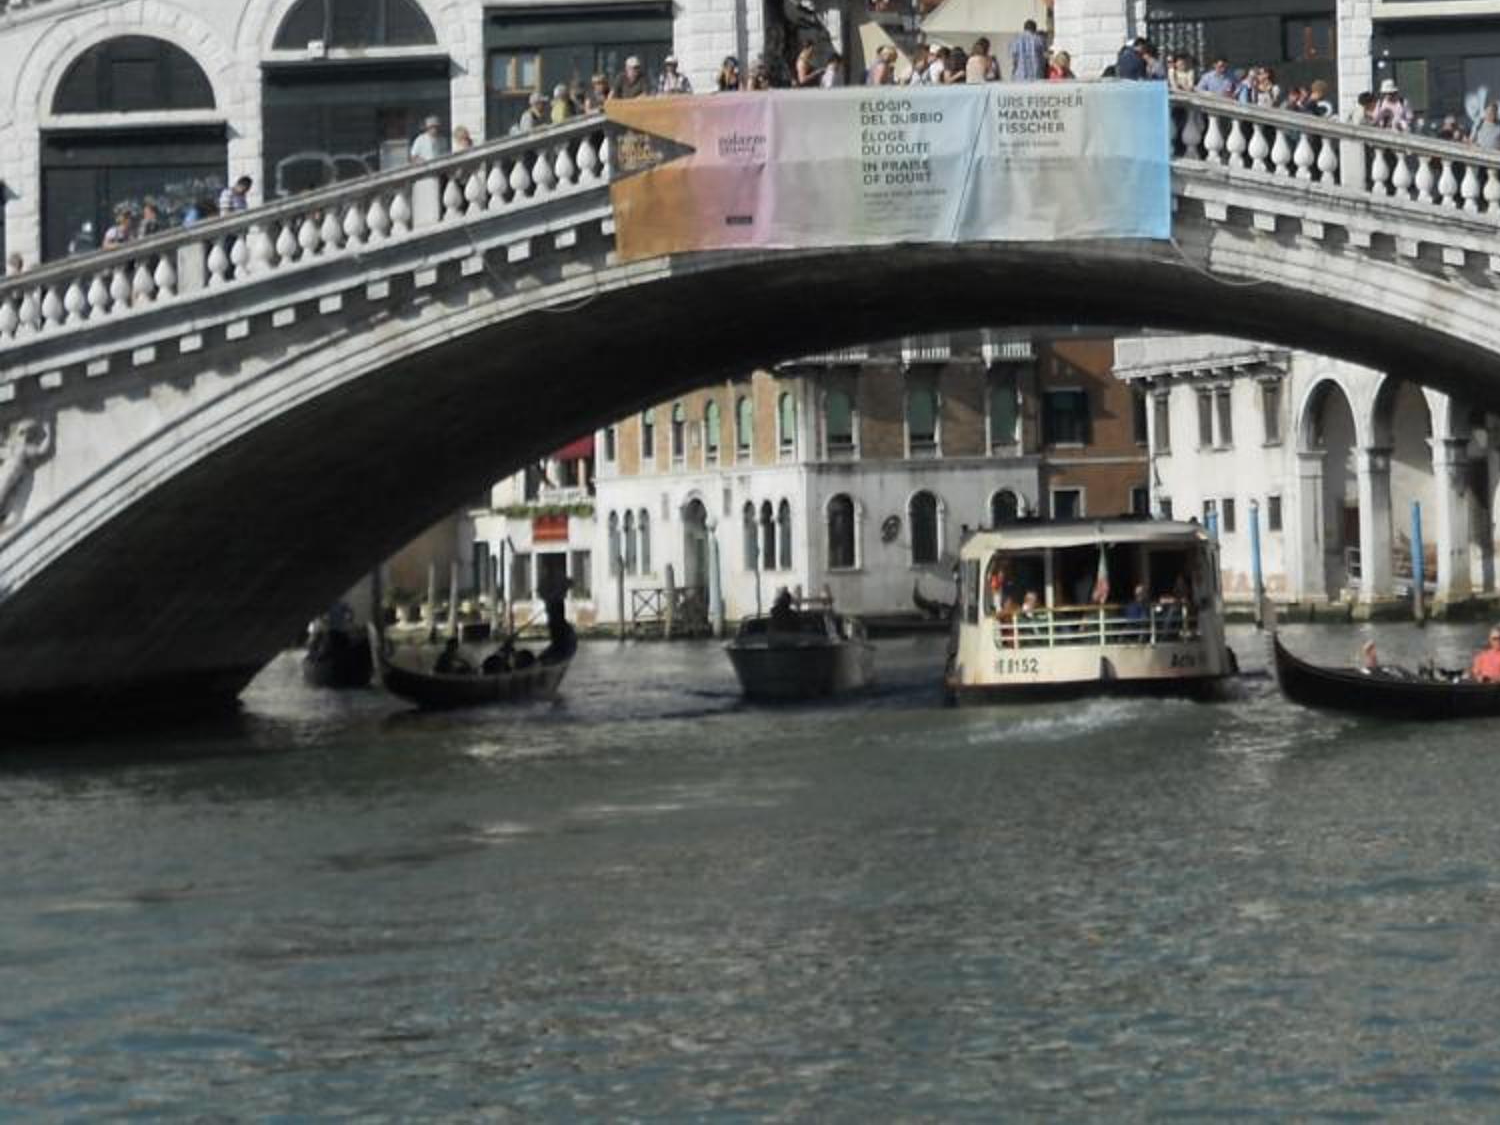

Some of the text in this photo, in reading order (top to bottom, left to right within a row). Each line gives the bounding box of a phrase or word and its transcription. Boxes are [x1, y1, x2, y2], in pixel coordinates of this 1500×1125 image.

[861, 114, 886, 126] DEL
[998, 109, 1059, 121] MADAME
[862, 144, 881, 156] DU
[863, 161, 877, 172] IN
[863, 174, 880, 186] OF
